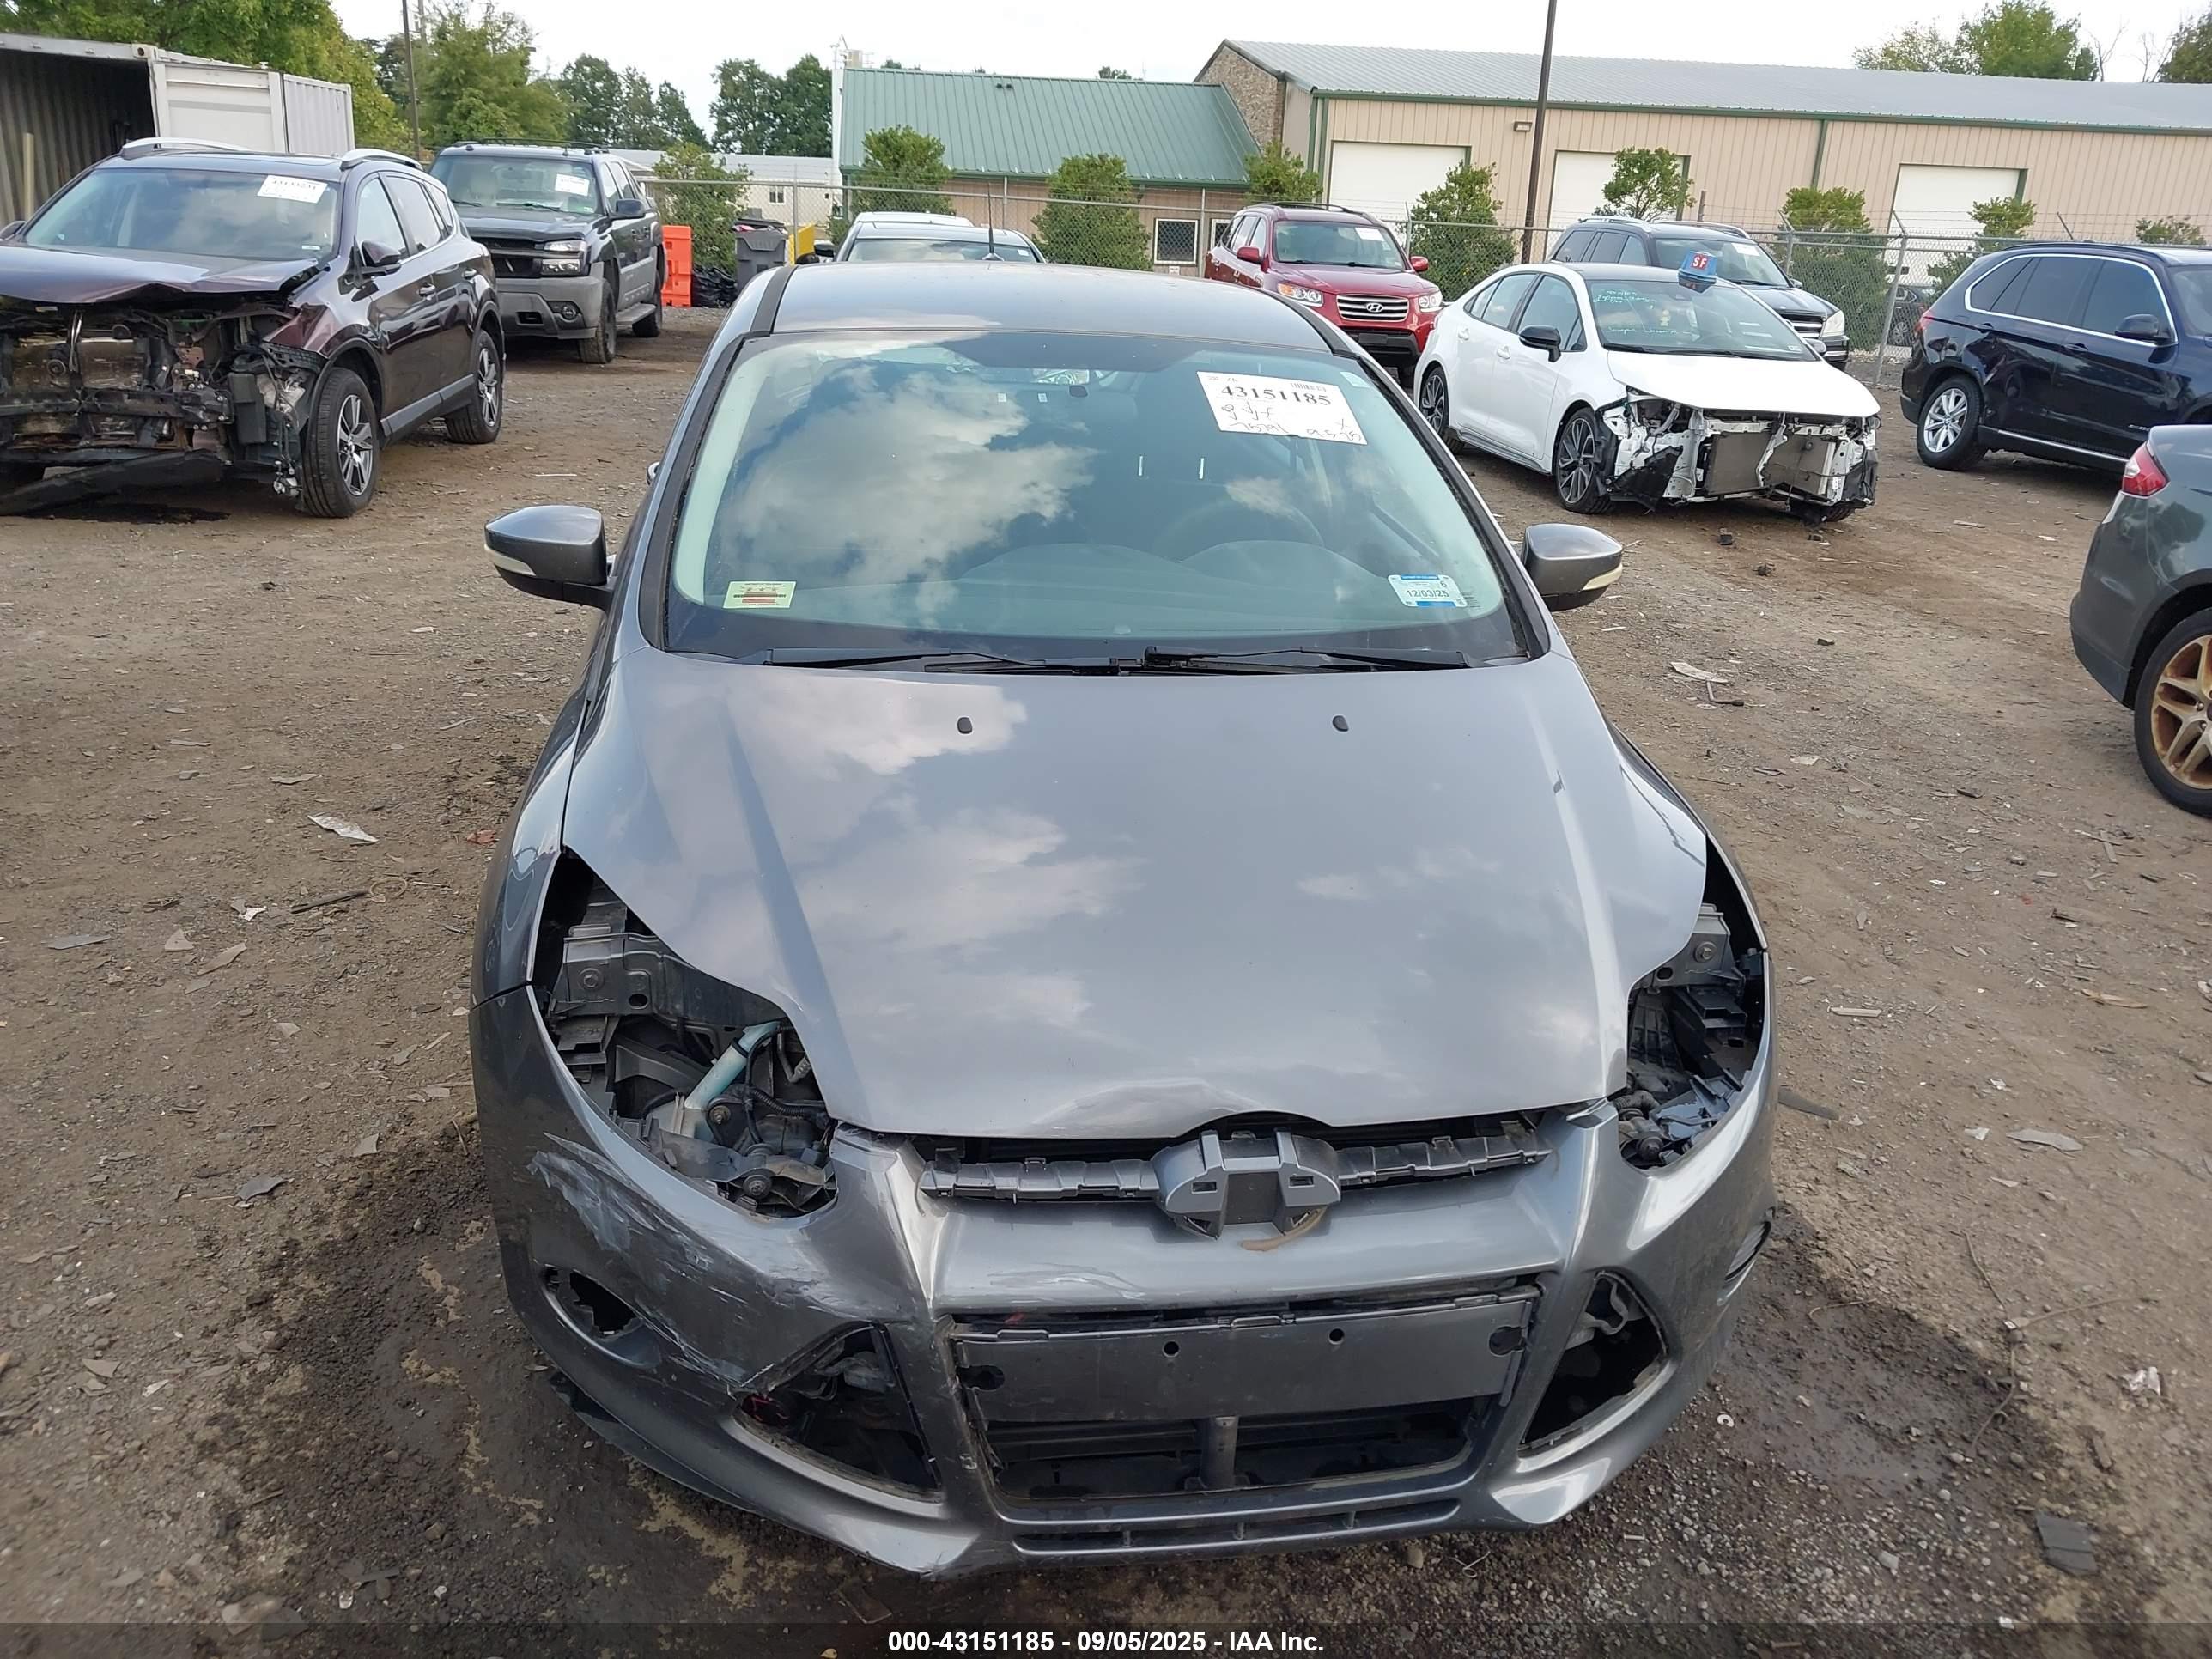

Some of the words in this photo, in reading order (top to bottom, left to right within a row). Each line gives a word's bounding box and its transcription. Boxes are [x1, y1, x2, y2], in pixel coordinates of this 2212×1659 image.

[1692, 256, 1707, 268] SF
[1220, 386, 1332, 406] 43151185
[1406, 589, 1449, 598] 12/03/25
